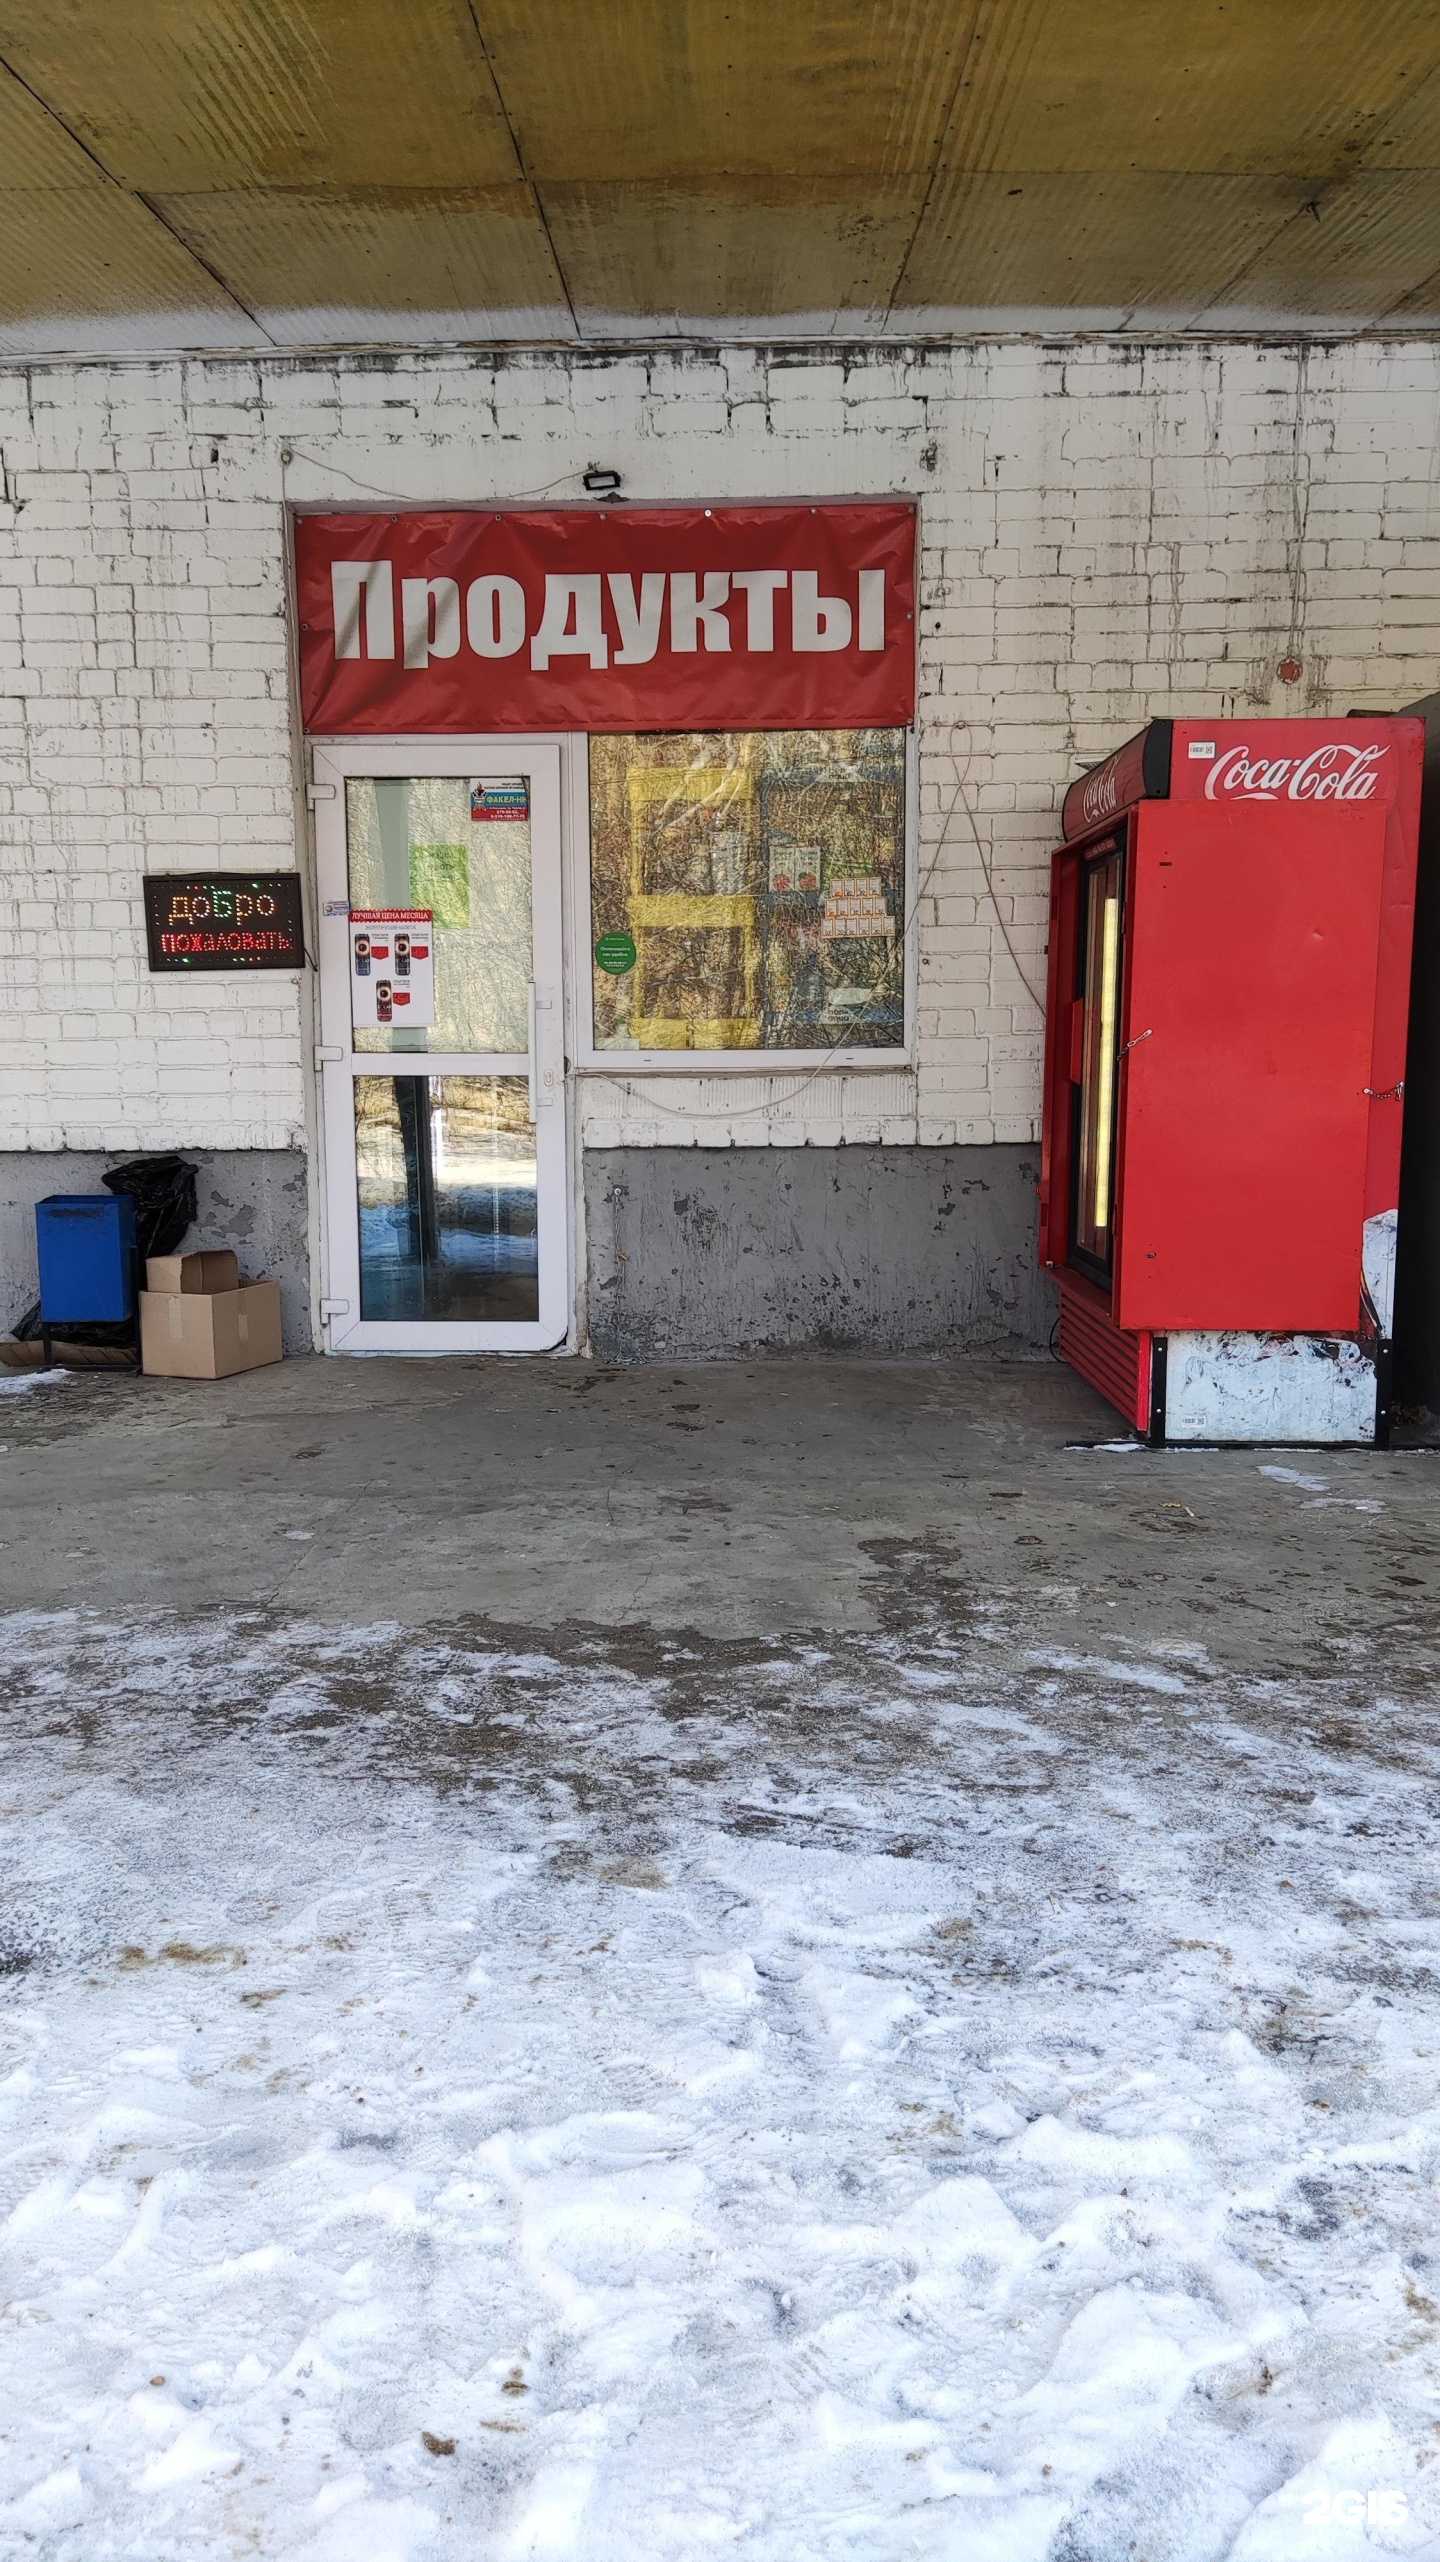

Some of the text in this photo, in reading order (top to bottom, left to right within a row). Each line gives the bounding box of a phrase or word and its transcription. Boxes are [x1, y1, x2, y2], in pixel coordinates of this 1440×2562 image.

[330, 560, 886, 671] Продукты
[1204, 744, 1391, 800] Coca-Cola
[352, 912, 428, 920] ЛУЧШАЯ ЦЕНА МЕСЯЦА
